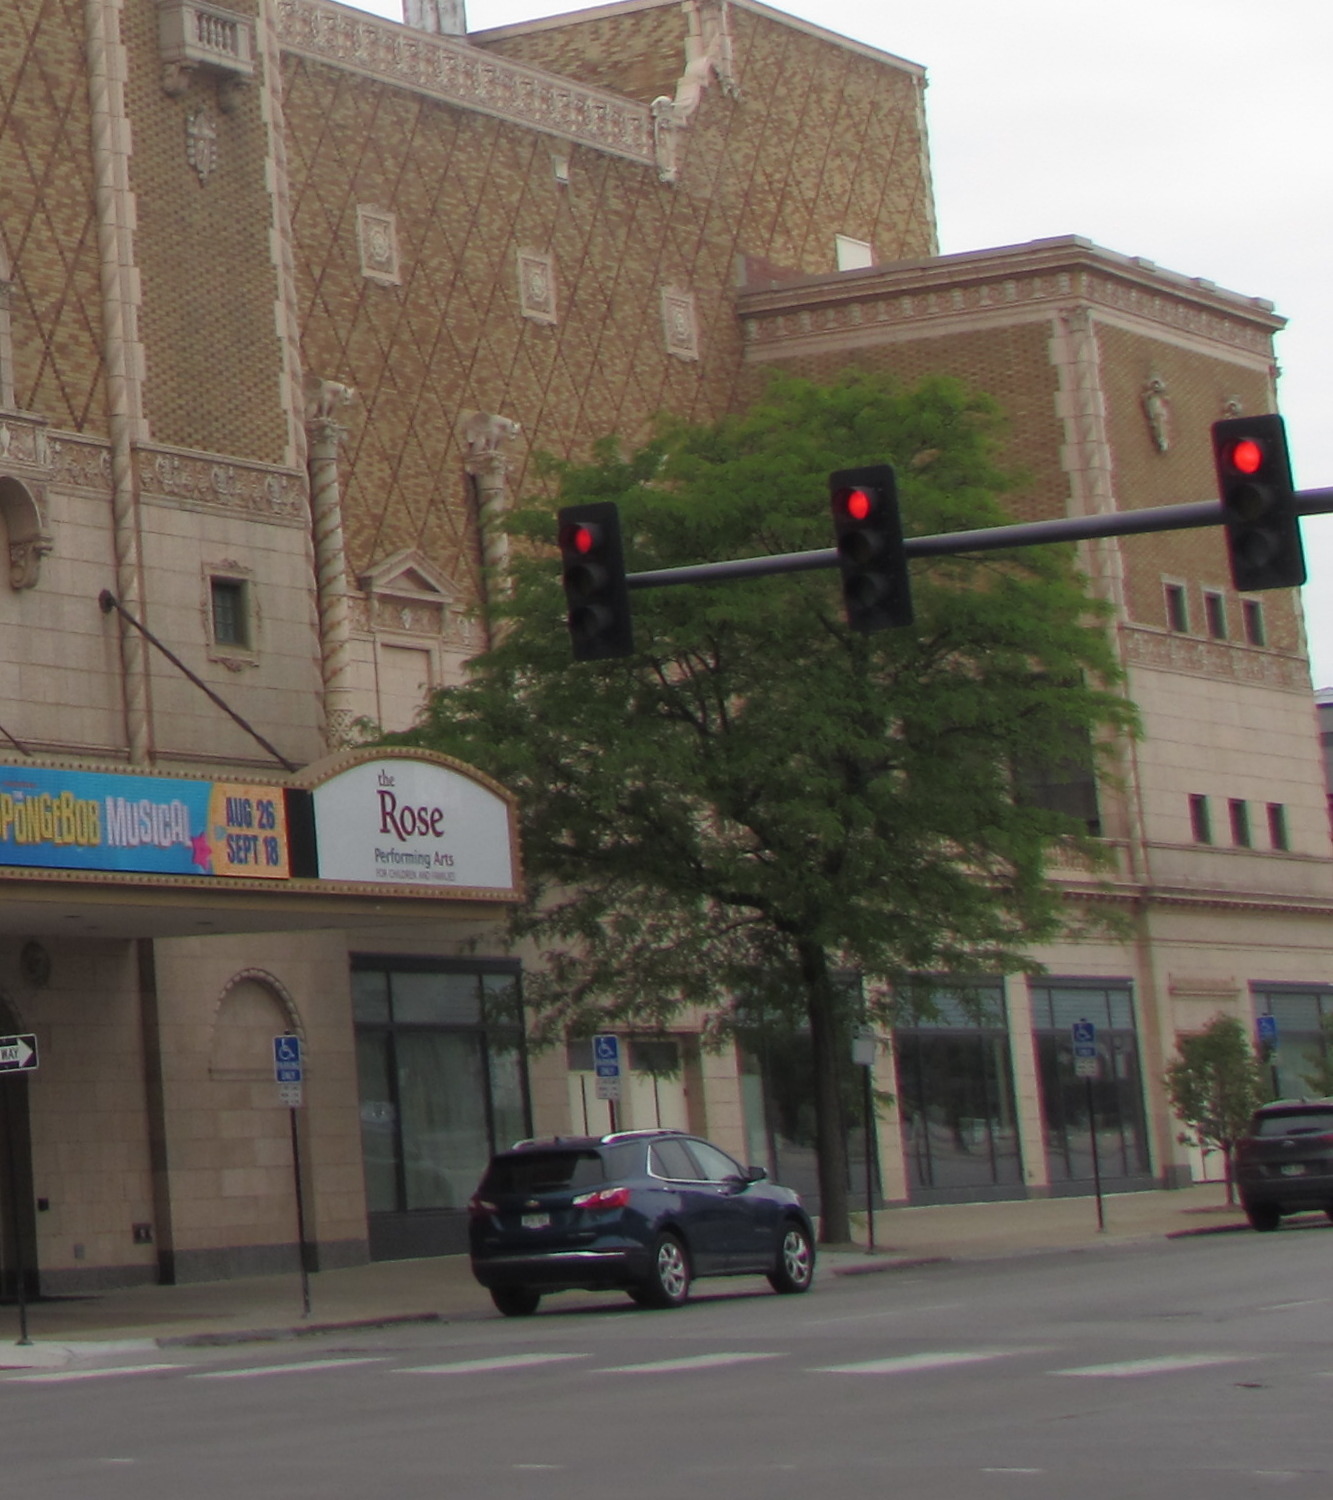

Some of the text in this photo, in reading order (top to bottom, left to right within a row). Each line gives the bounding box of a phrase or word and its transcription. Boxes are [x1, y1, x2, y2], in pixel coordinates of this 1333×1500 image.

[378, 769, 395, 787] the
[104, 795, 193, 848] MUSICAL
[226, 797, 275, 830] AUG 26
[376, 790, 444, 842] Rose
[226, 833, 279, 866] SEPT 18
[374, 848, 454, 869] Performing Arts
[1, 1047, 18, 1060] WAY
